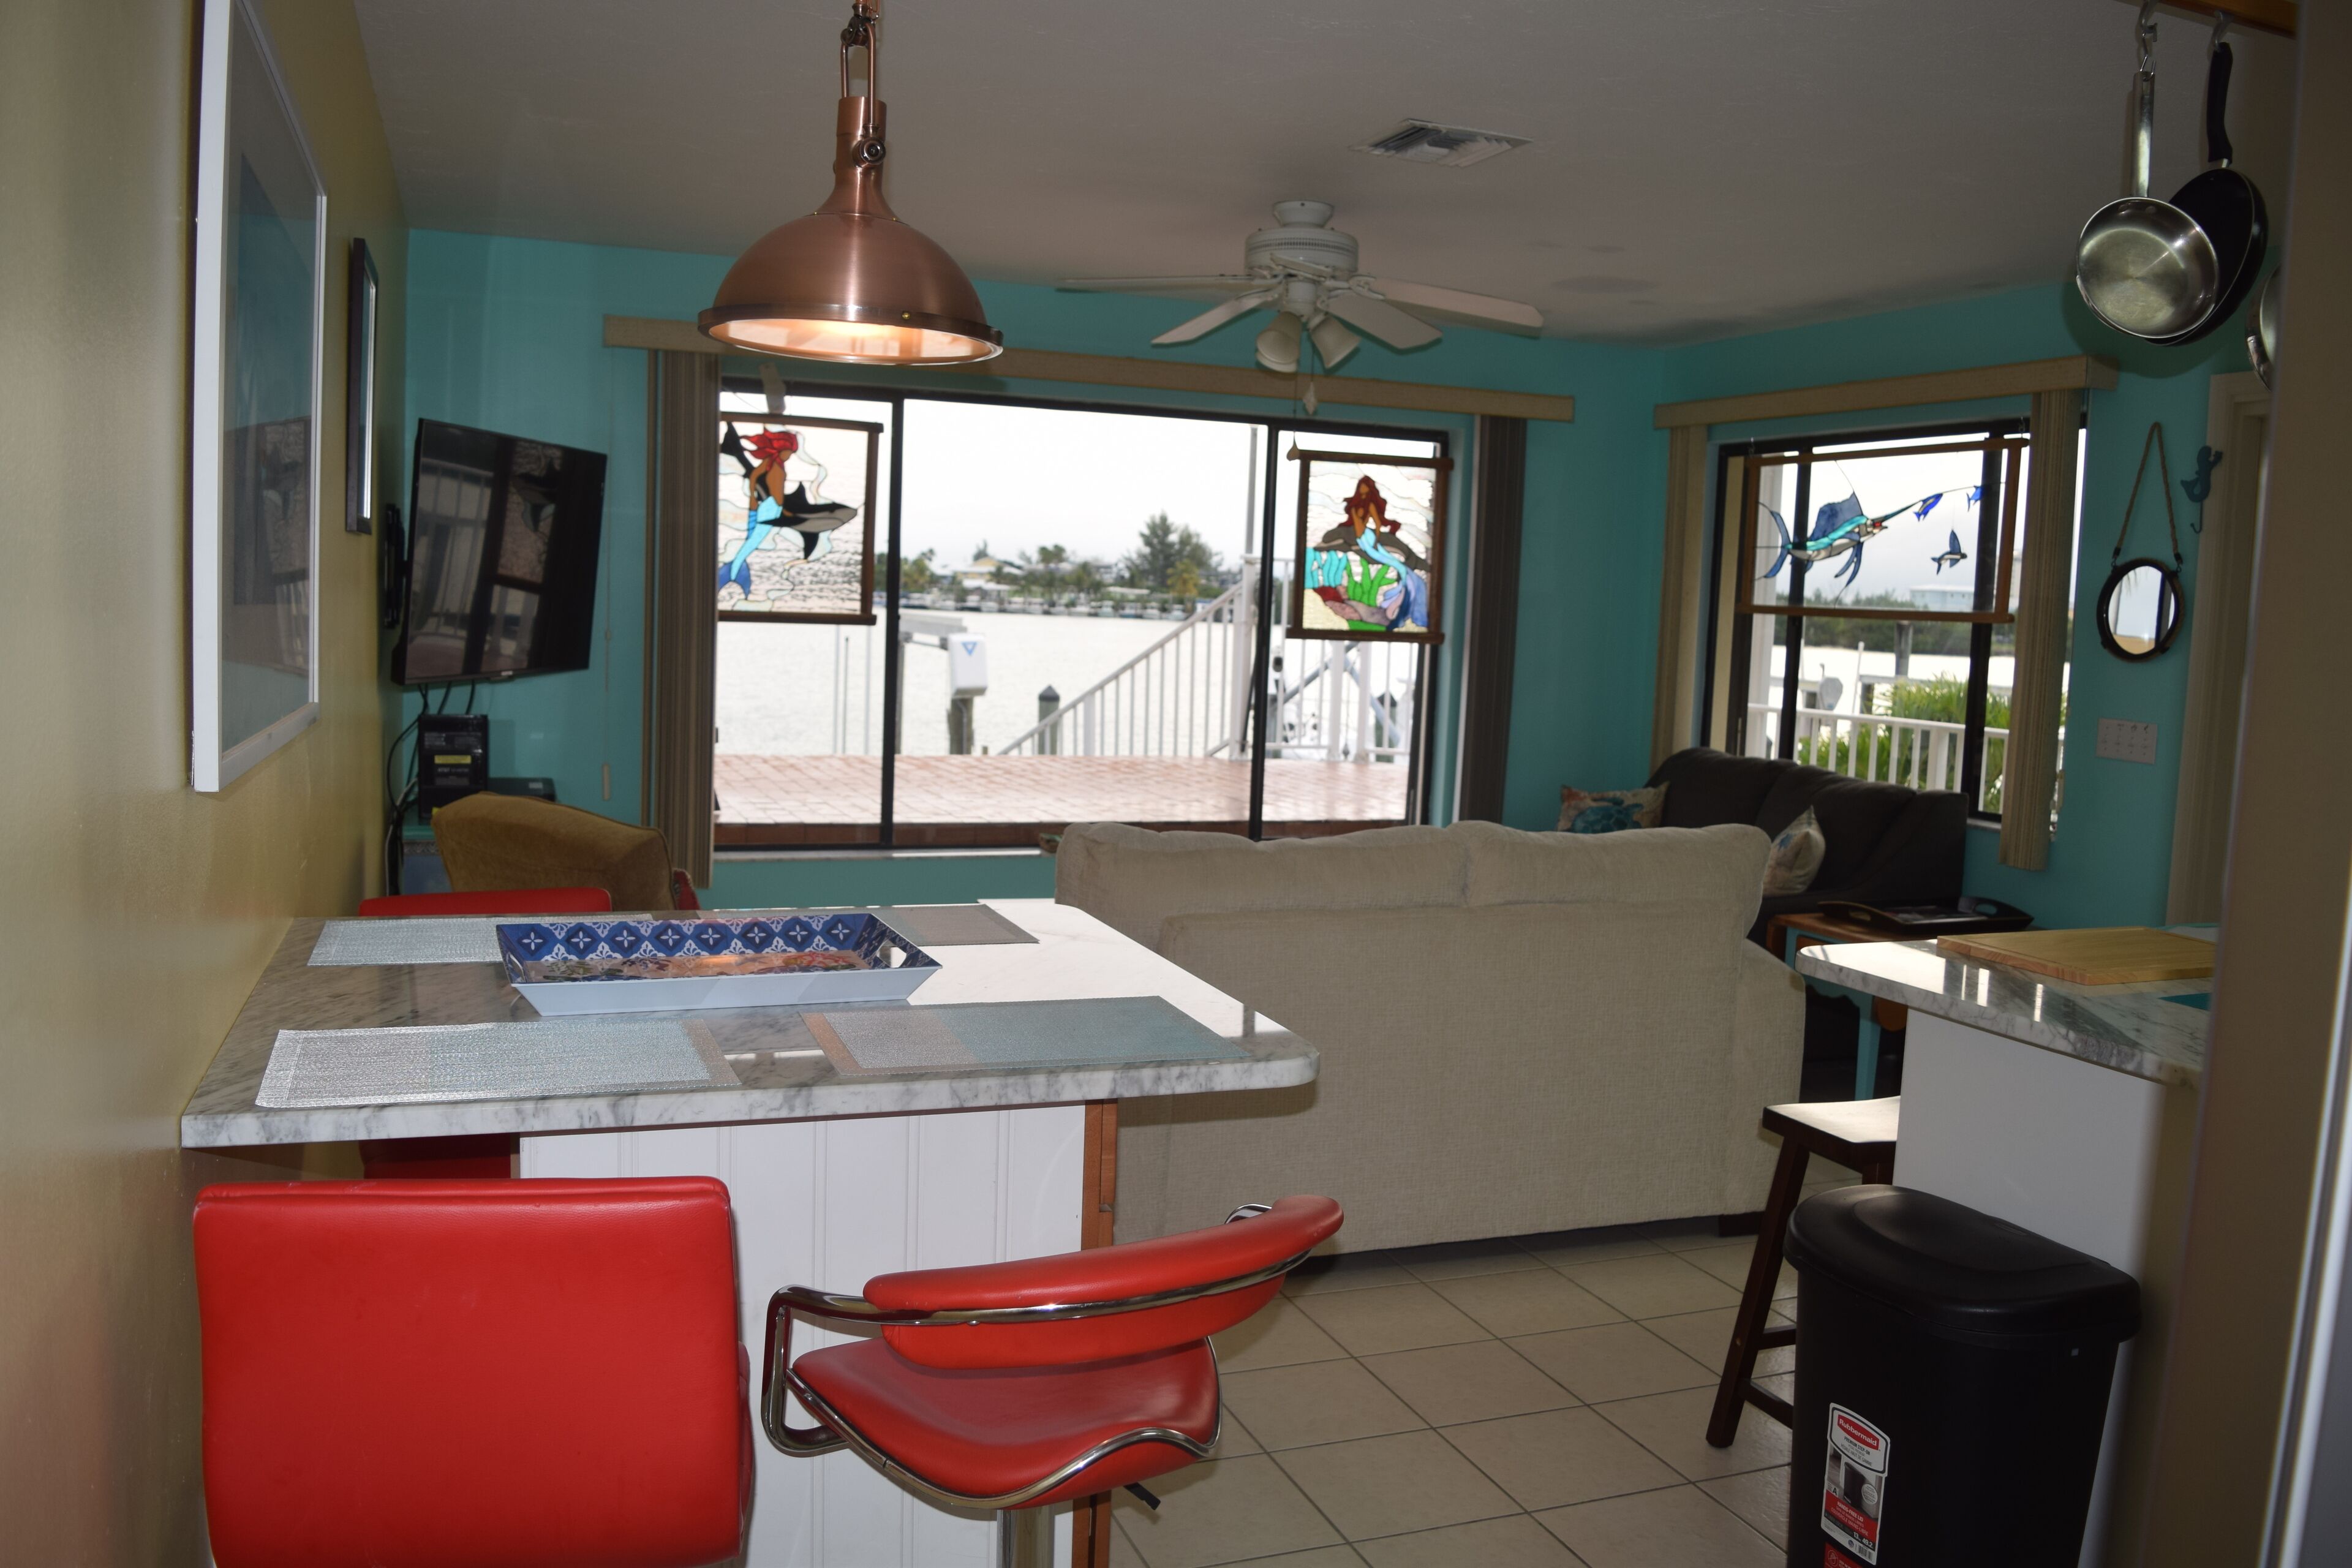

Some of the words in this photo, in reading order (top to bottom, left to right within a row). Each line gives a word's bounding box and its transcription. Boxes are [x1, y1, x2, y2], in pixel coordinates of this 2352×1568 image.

[1839, 1419, 1877, 1446] Rubbermaid
[1833, 1487, 1837, 1496] A
[1862, 1538, 1873, 1547] 49.2
